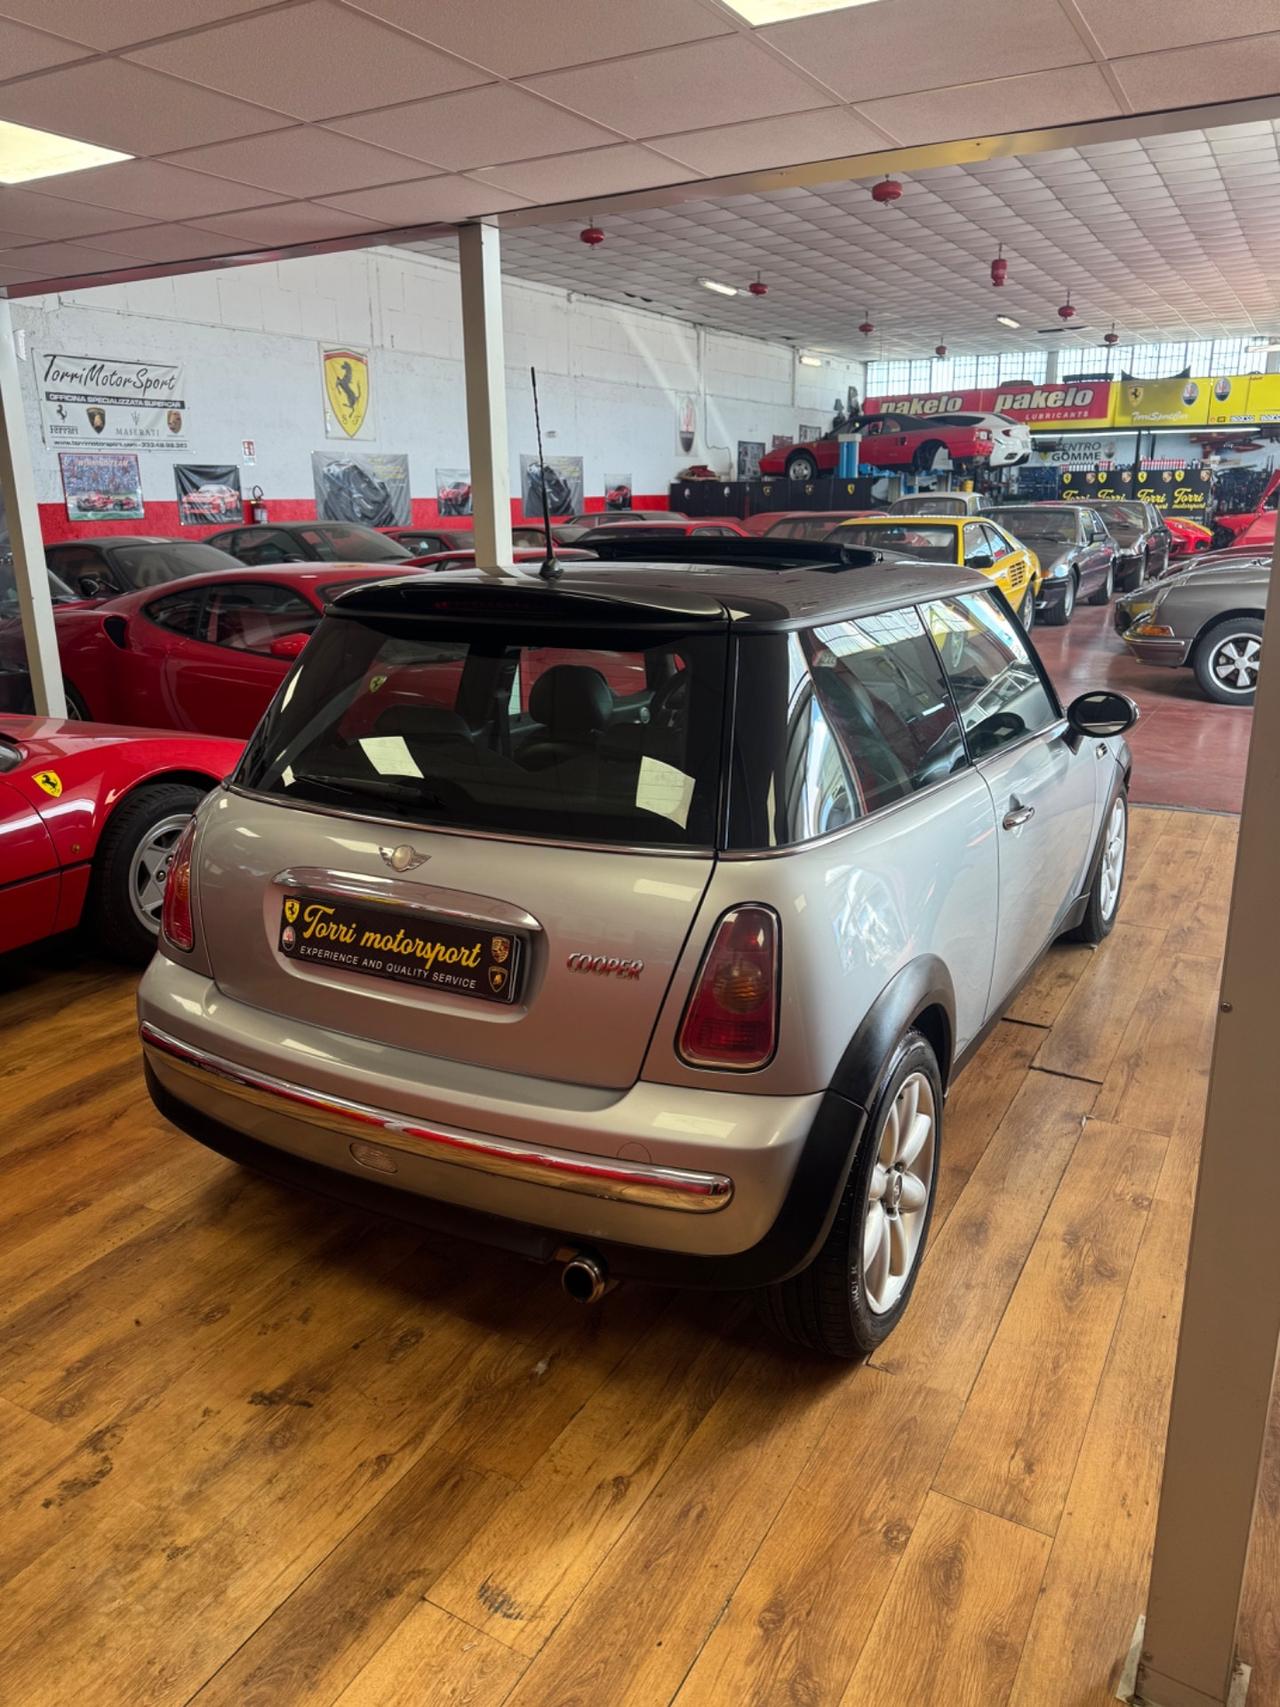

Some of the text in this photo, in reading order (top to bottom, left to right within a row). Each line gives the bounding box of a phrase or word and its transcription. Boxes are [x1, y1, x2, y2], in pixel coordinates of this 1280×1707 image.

[43, 354, 179, 396] TorriMotorSport
[49, 393, 86, 403] OFFICINA
[994, 388, 1094, 414] pakelo
[1025, 411, 1089, 420] LUBRICANTS
[1061, 442, 1102, 451] ENTRO
[1052, 452, 1101, 461] GOMME
[1137, 488, 1167, 503] Torri
[1174, 487, 1204, 504] Torri
[303, 905, 481, 969] Torri motorsport
[300, 945, 477, 990] EXPERIENCE AND QUALITY SERVICE
[566, 952, 645, 980] COOPER
